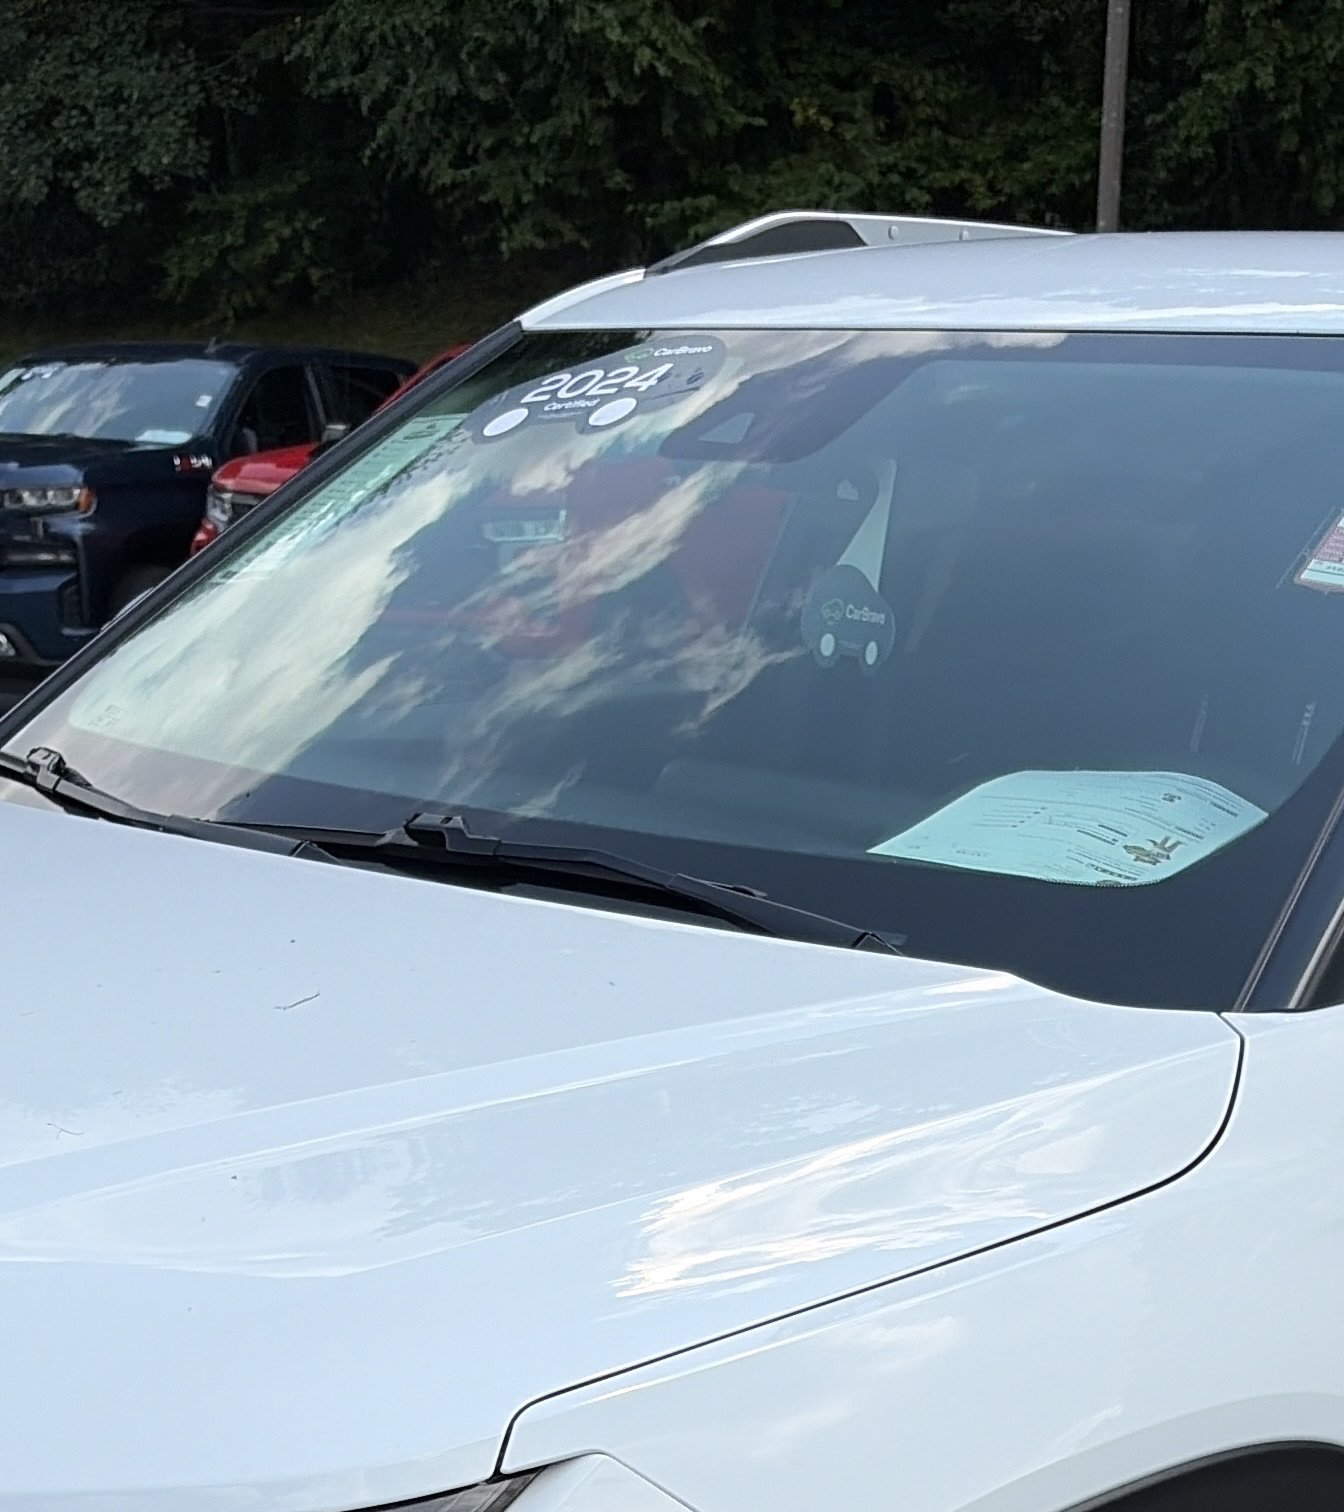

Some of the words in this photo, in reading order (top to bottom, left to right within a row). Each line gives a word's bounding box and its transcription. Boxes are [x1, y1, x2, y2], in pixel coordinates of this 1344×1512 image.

[653, 345, 713, 357] CarBravo
[520, 363, 674, 403] 2024
[543, 398, 600, 412] Certified
[845, 604, 886, 625] CarBravo
